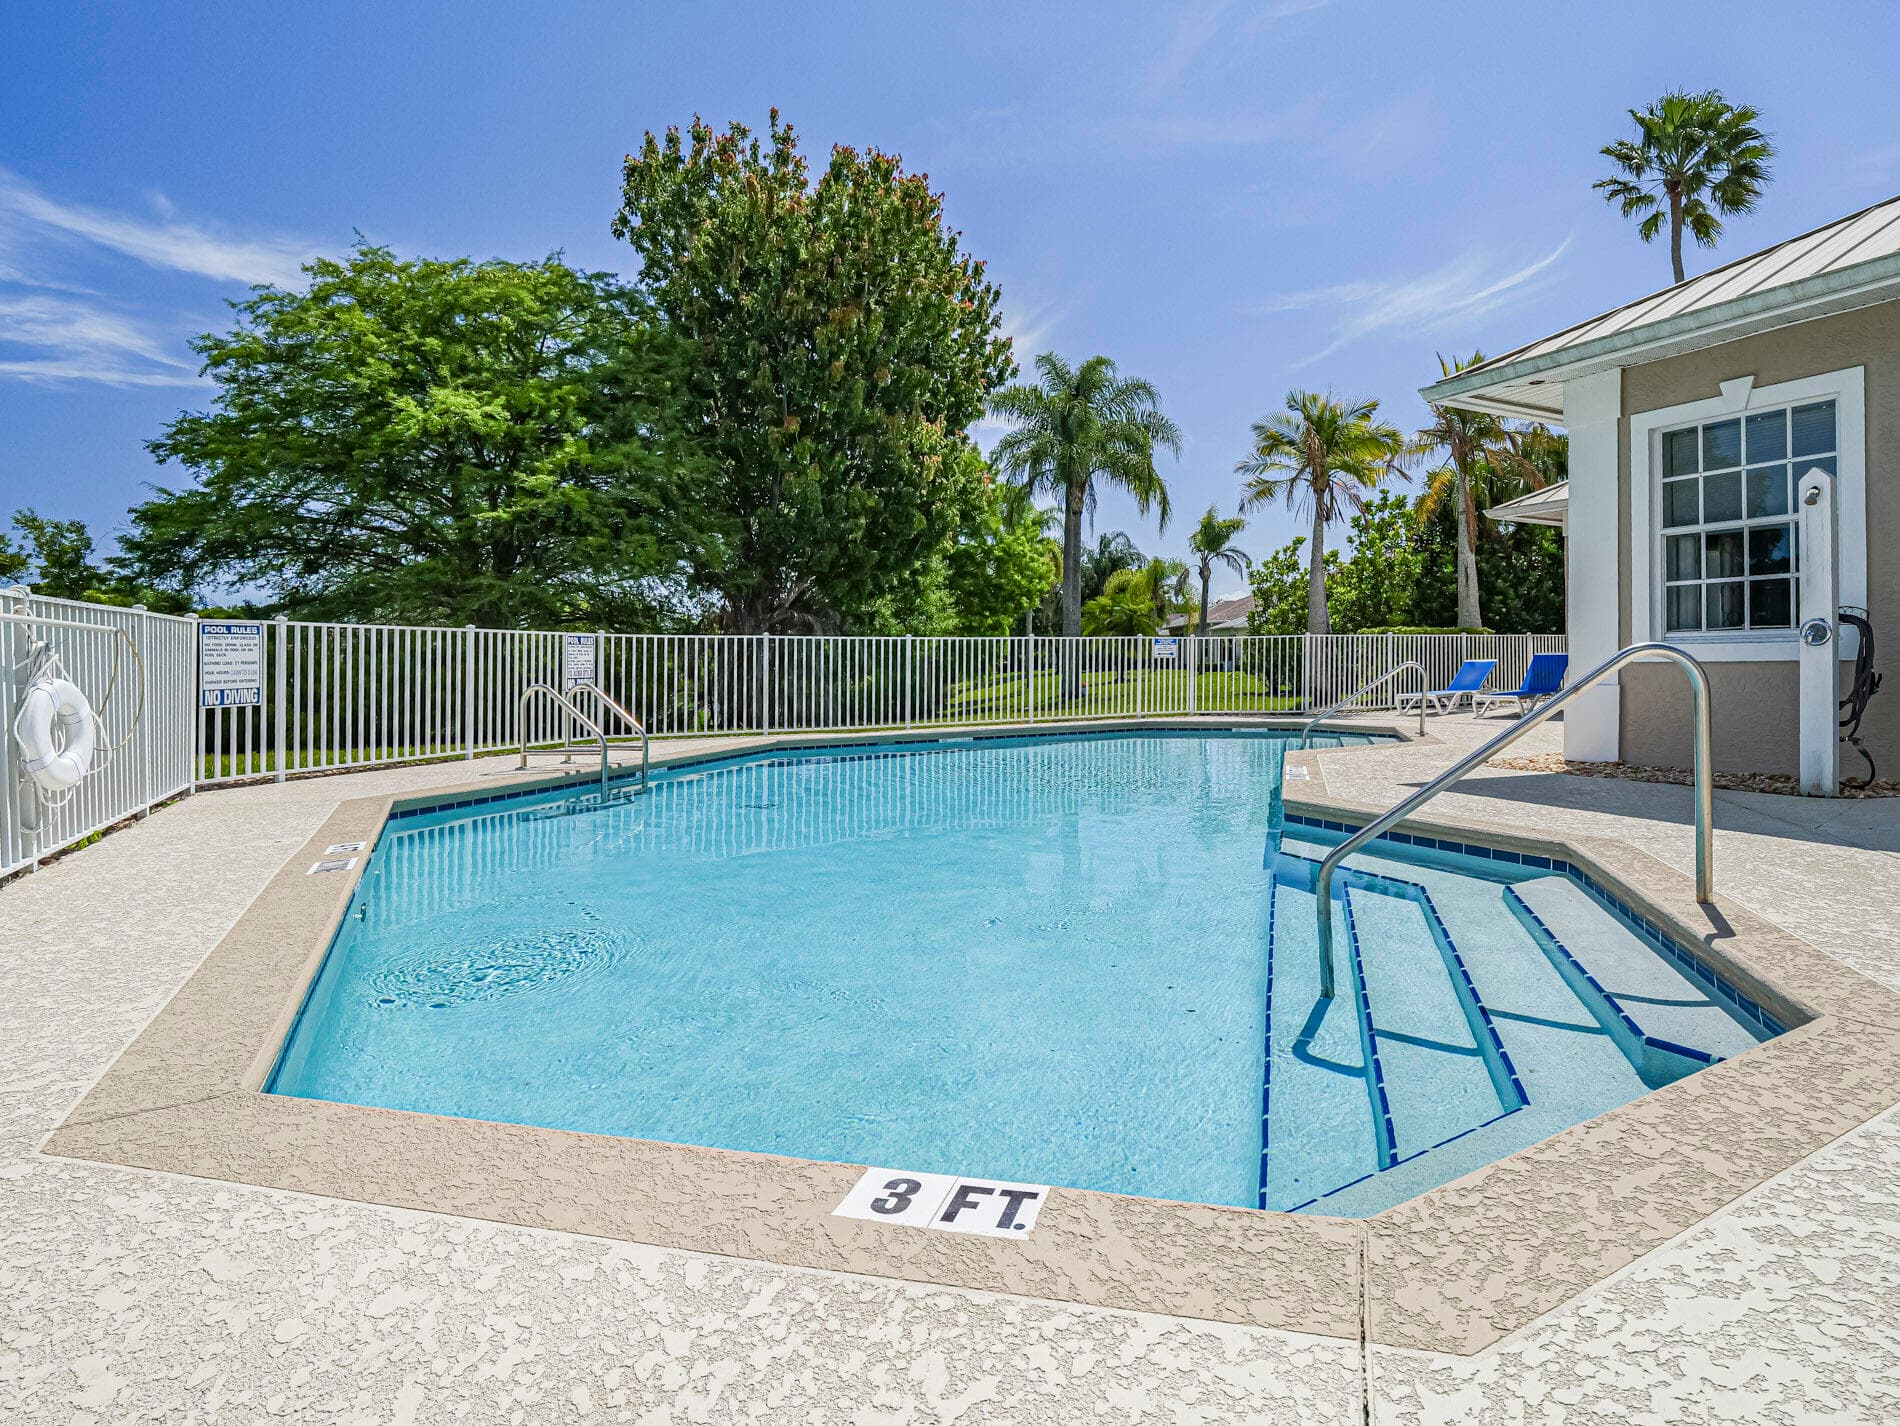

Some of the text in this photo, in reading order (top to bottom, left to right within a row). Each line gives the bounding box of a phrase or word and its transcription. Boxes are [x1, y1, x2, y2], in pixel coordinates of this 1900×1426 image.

[205, 689, 258, 705] NO DIVING
[870, 1178, 1039, 1231] 3 FT.
